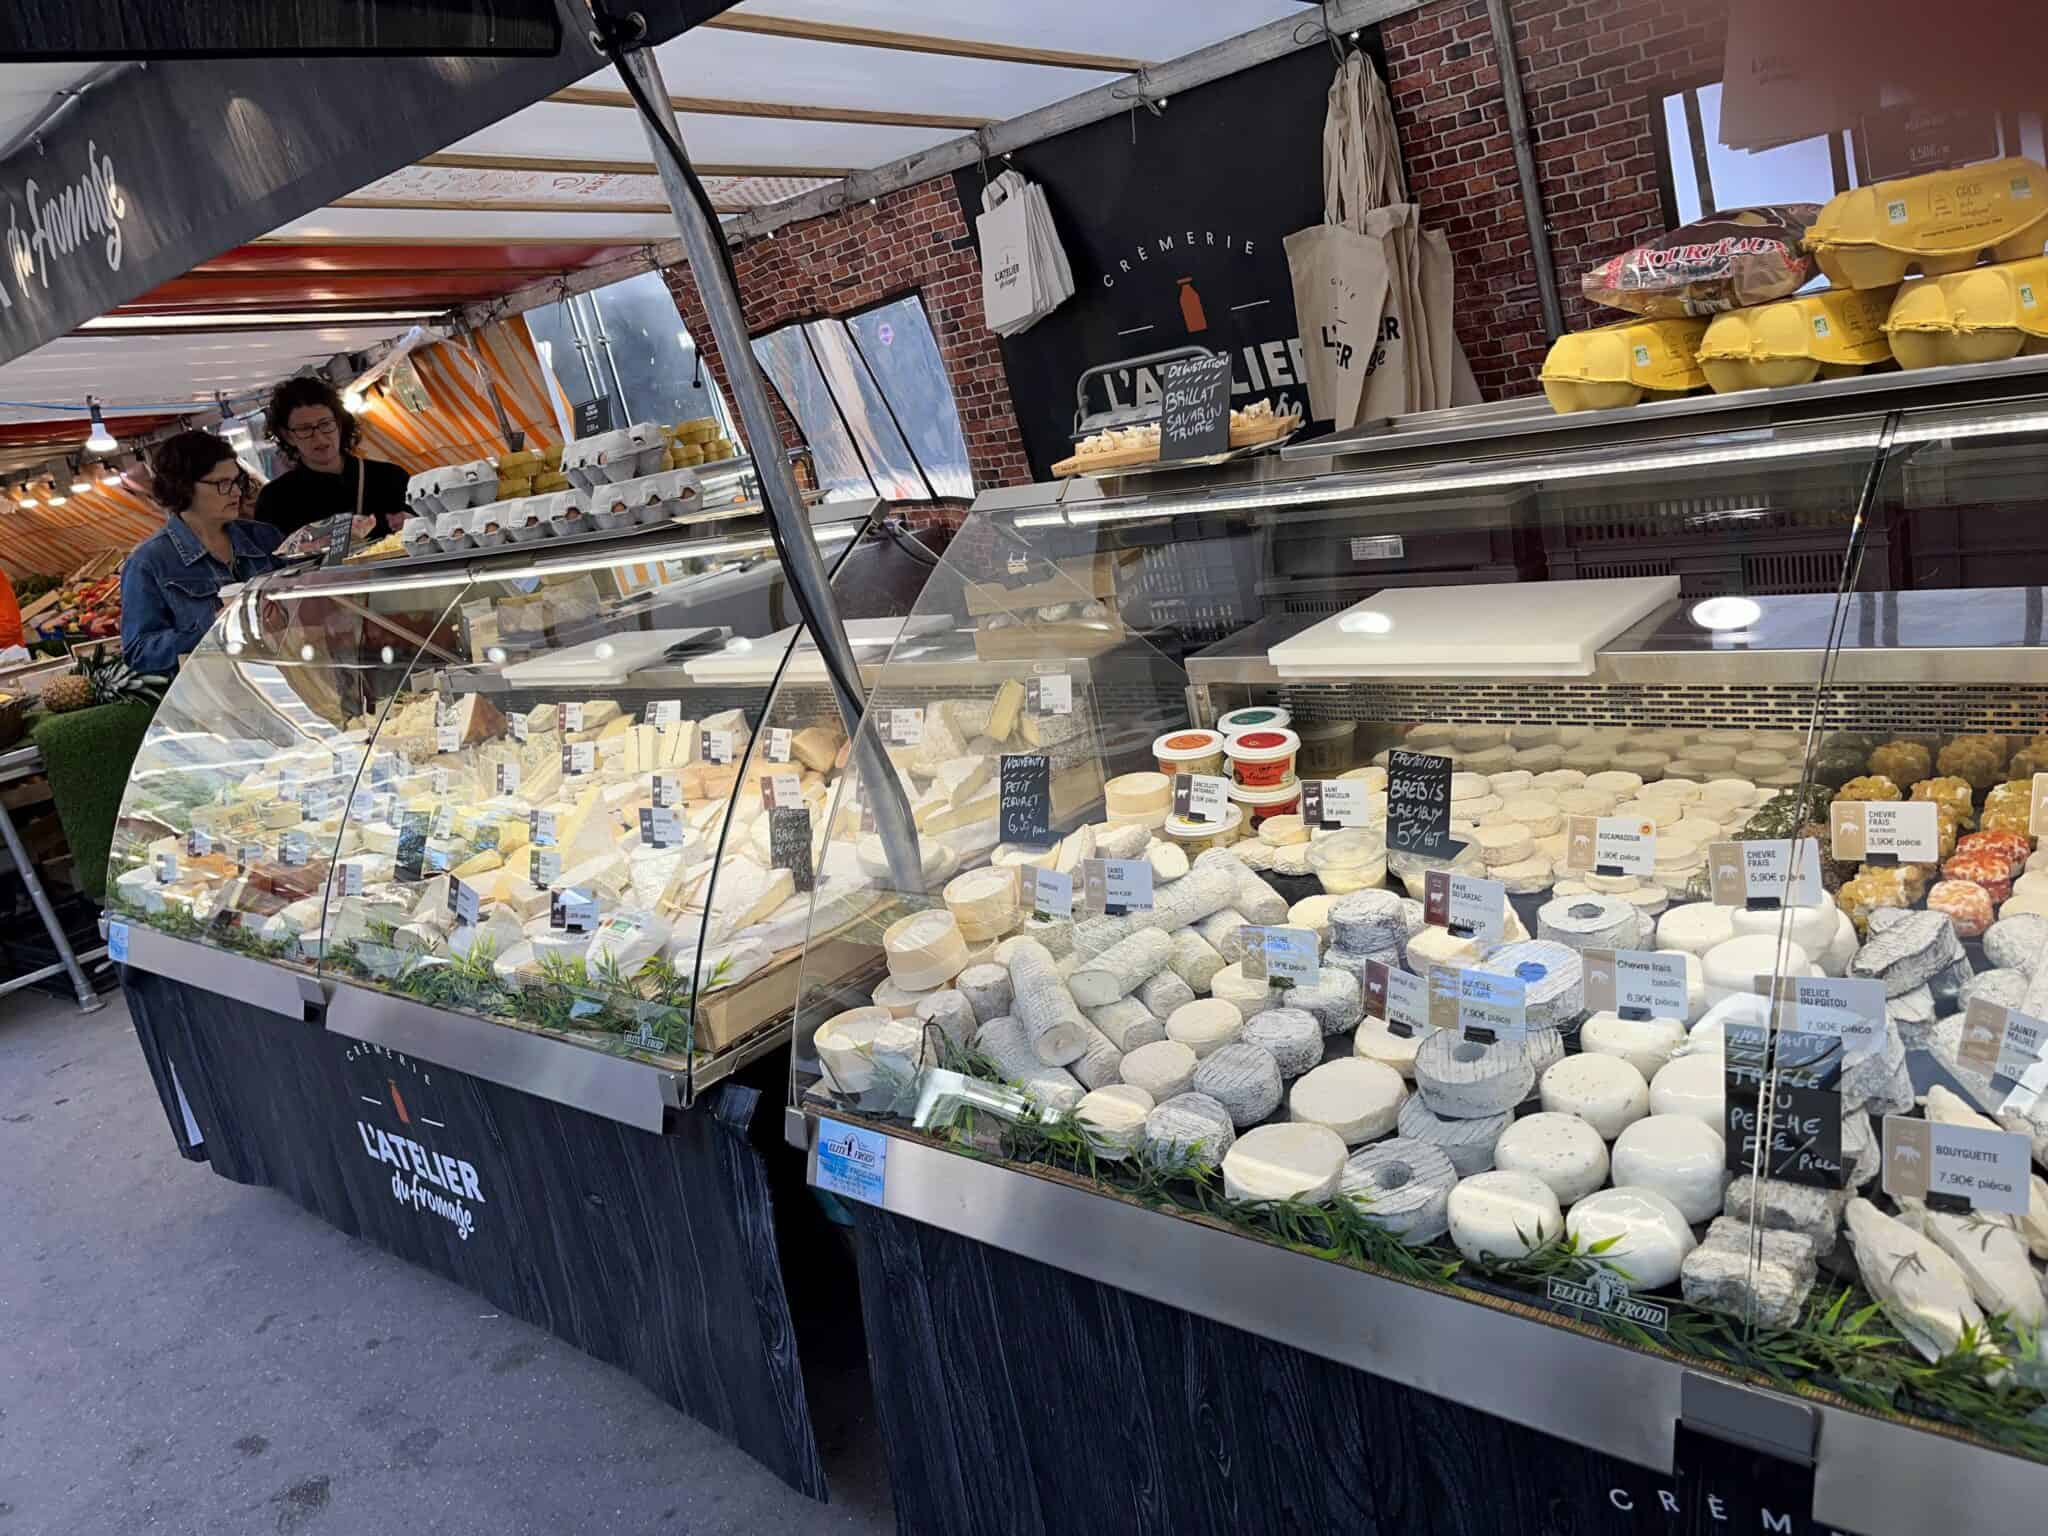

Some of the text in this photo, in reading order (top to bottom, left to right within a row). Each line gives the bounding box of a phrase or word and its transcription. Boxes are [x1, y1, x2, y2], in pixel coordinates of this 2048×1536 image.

[1102, 230, 1255, 288] CRÈMERIE
[1868, 810, 1898, 820] CHEVRE
[1746, 849, 1777, 860] CHEVRE
[1800, 988, 1831, 998] DELICE
[357, 1120, 487, 1203] L'ATELIER
[391, 1169, 475, 1242] du fromage
[1551, 1282, 1664, 1325] ELITE FROID
[1608, 1488, 1843, 1536] CRÈM
